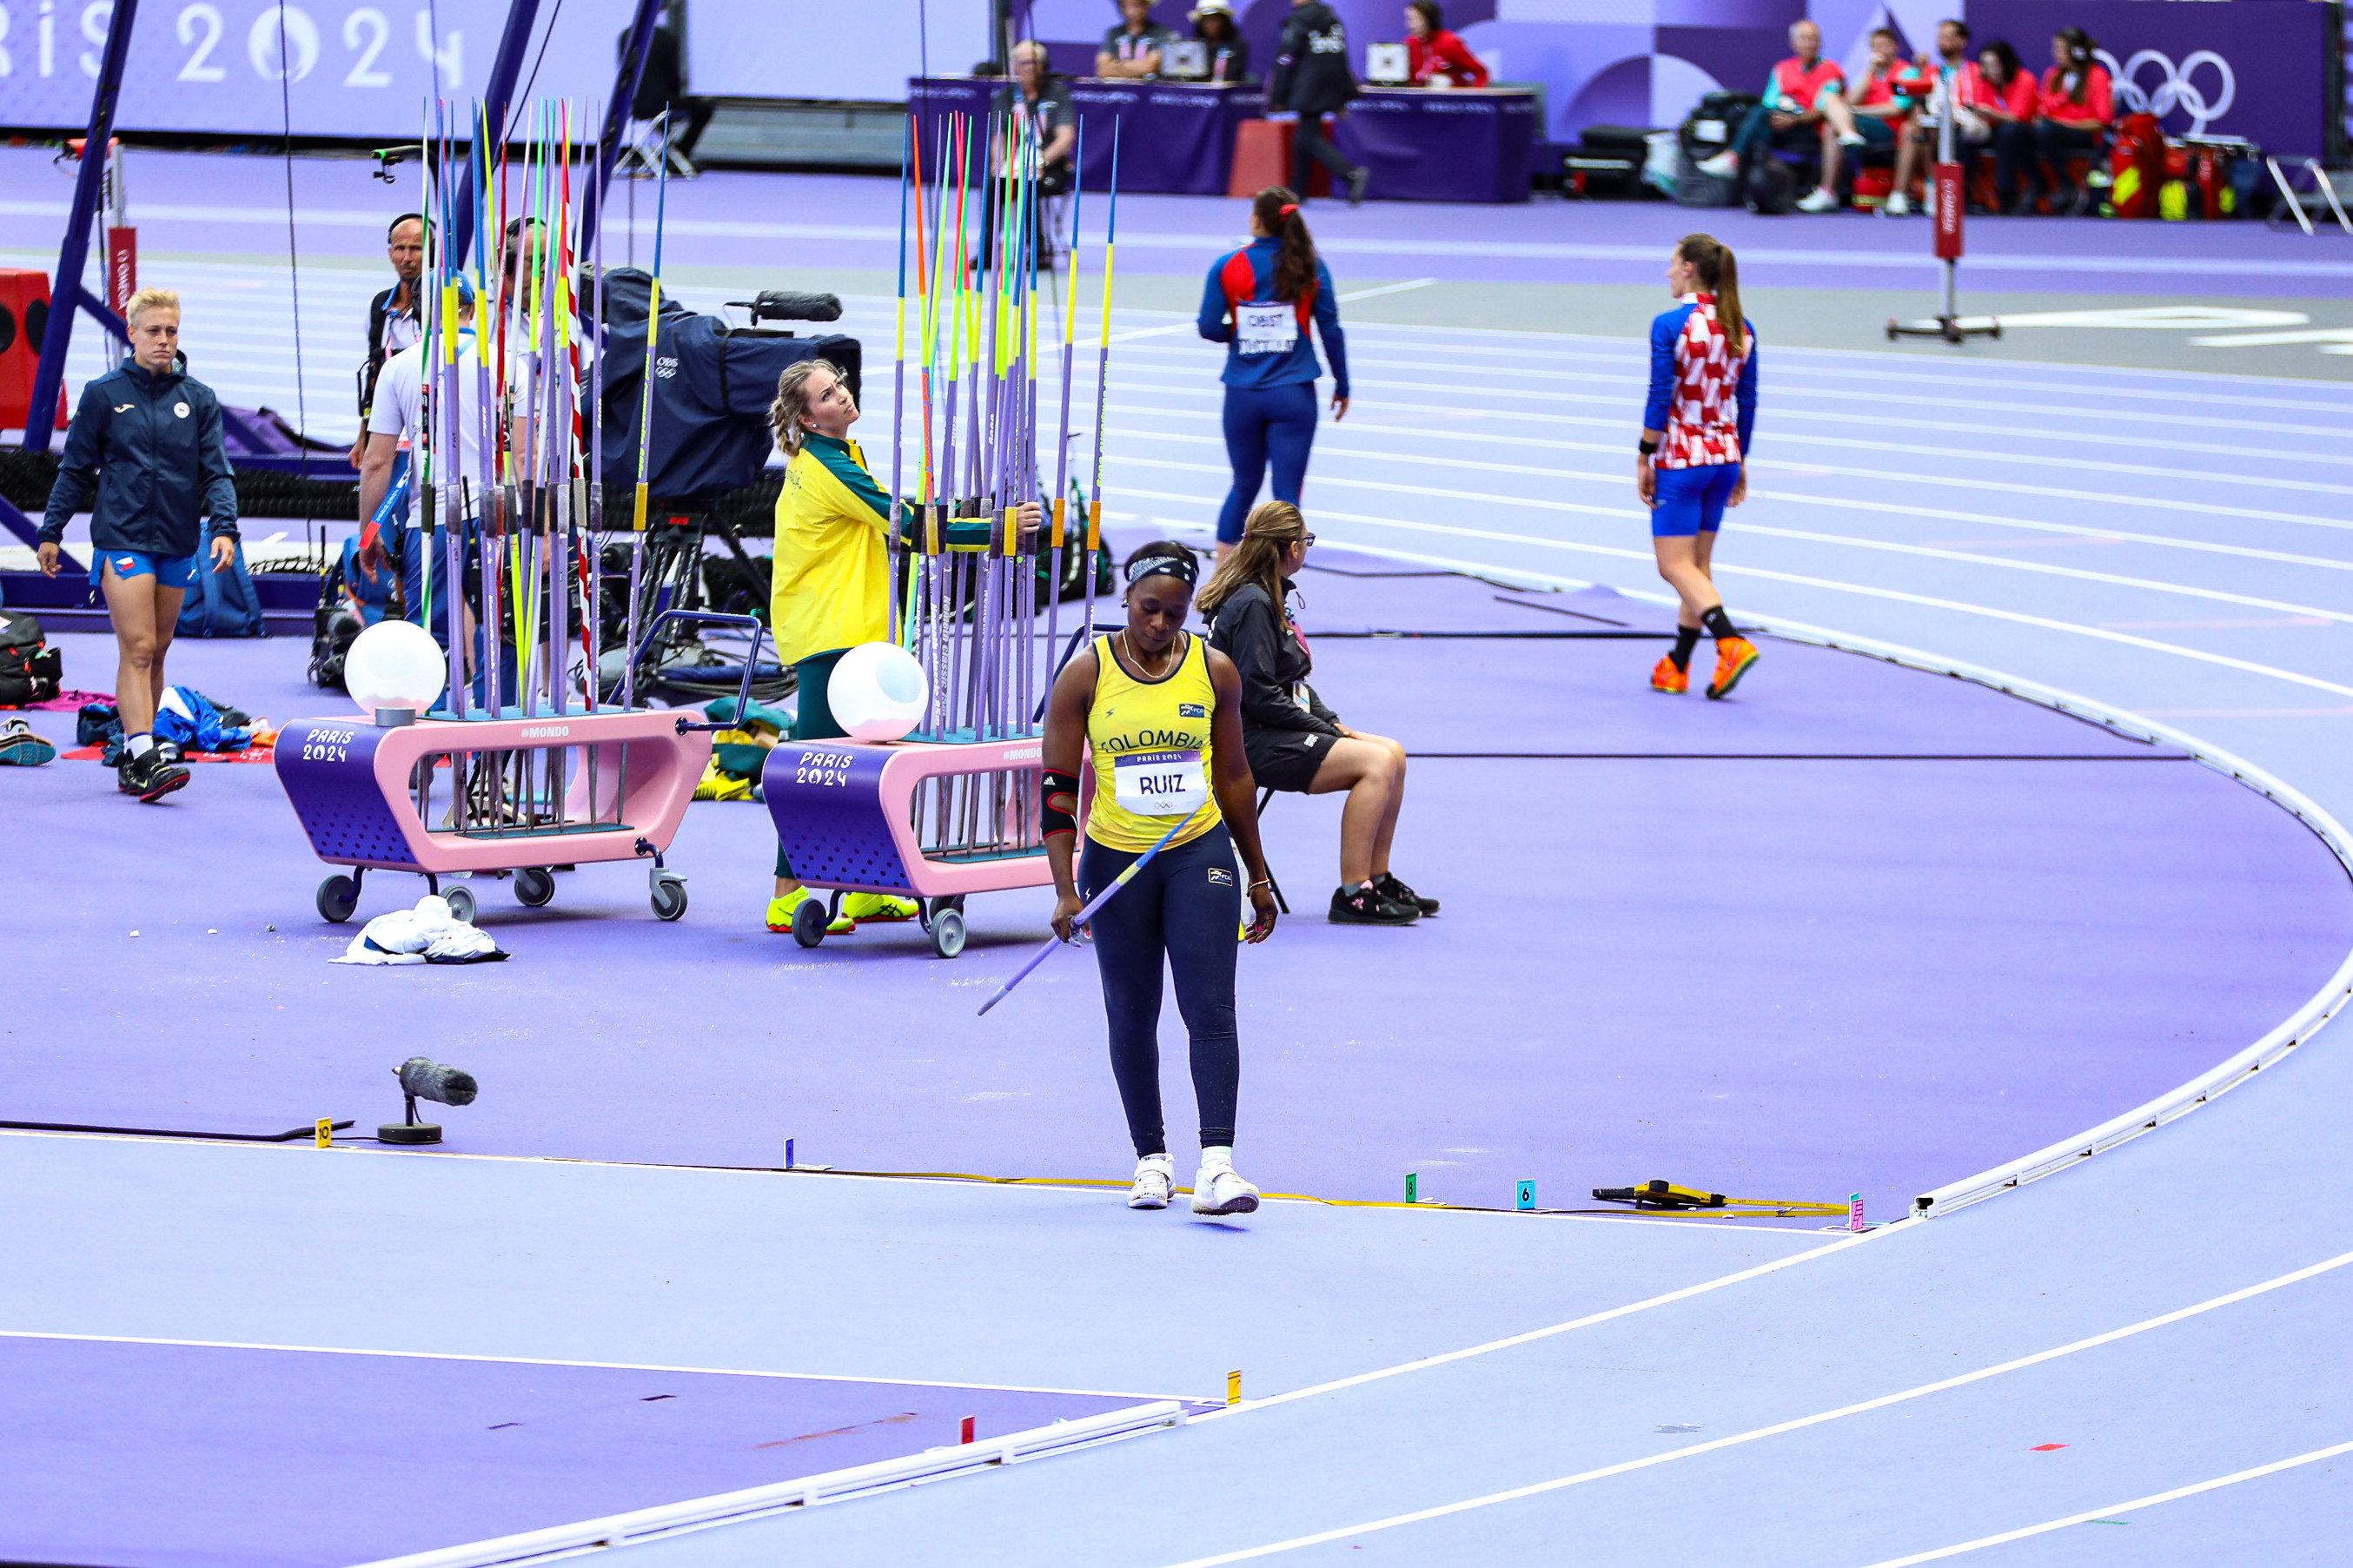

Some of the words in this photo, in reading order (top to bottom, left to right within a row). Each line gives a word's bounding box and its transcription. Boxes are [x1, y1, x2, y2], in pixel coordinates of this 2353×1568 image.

[176, 3, 463, 89] 2024
[307, 729, 355, 744] PARIS
[529, 726, 569, 738] MONDO
[302, 744, 346, 763] 2024
[799, 751, 853, 769] PARIS
[1010, 747, 1042, 760] MONDO
[1137, 754, 1160, 763] PARIS
[796, 767, 847, 787] 2024
[1139, 773, 1186, 795] RUIZ
[319, 1126, 328, 1140] 10
[1408, 1181, 1413, 1195] 8
[1521, 1188, 1529, 1201] 6
